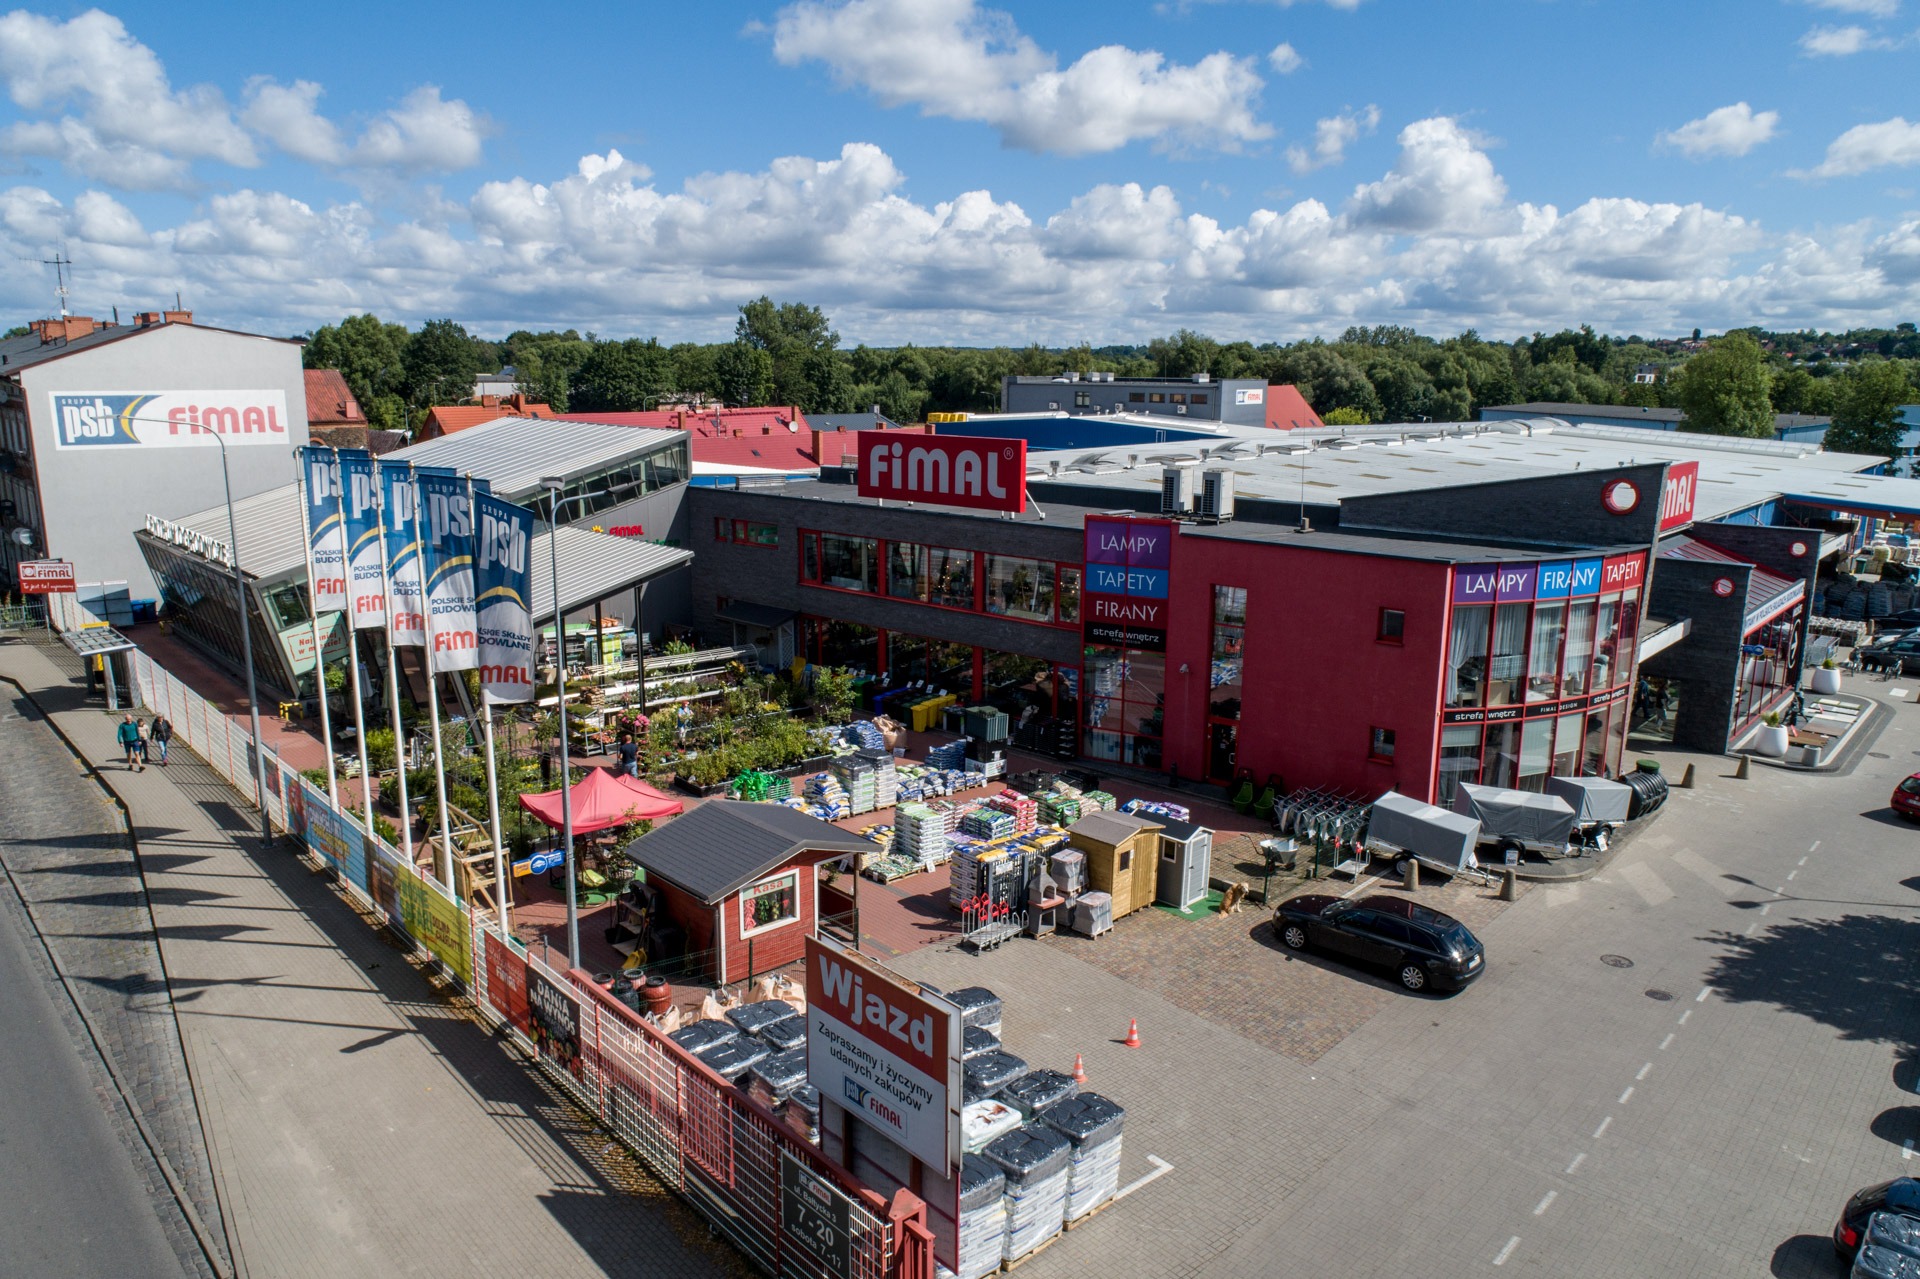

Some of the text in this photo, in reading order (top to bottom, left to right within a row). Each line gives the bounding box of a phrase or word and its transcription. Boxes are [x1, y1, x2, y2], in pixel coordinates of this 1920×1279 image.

[63, 399, 116, 443] psb
[428, 484, 461, 493] GRUPA
[482, 504, 507, 520] GRUPA
[480, 513, 526, 575] psb
[1101, 534, 1156, 554] LAMPY
[1097, 570, 1156, 591] TAPETY
[1543, 567, 1596, 590] FIRANY
[1606, 560, 1641, 583] TAPETY
[1465, 573, 1528, 594] LAMPY
[431, 597, 465, 605] POLSKIE
[1096, 600, 1158, 622] FIRANY
[1454, 709, 1516, 721] strefa wnętrz
[753, 880, 783, 895] Kasa
[537, 979, 570, 1017] DANIA
[819, 954, 933, 1059] Wjazd
[818, 1021, 933, 1104] Zapraszamy i życzymy
[830, 1046, 922, 1112] udanych zakupów
[797, 1203, 806, 1223] 7
[816, 1219, 834, 1247] 20
[791, 1224, 817, 1250] sobota
